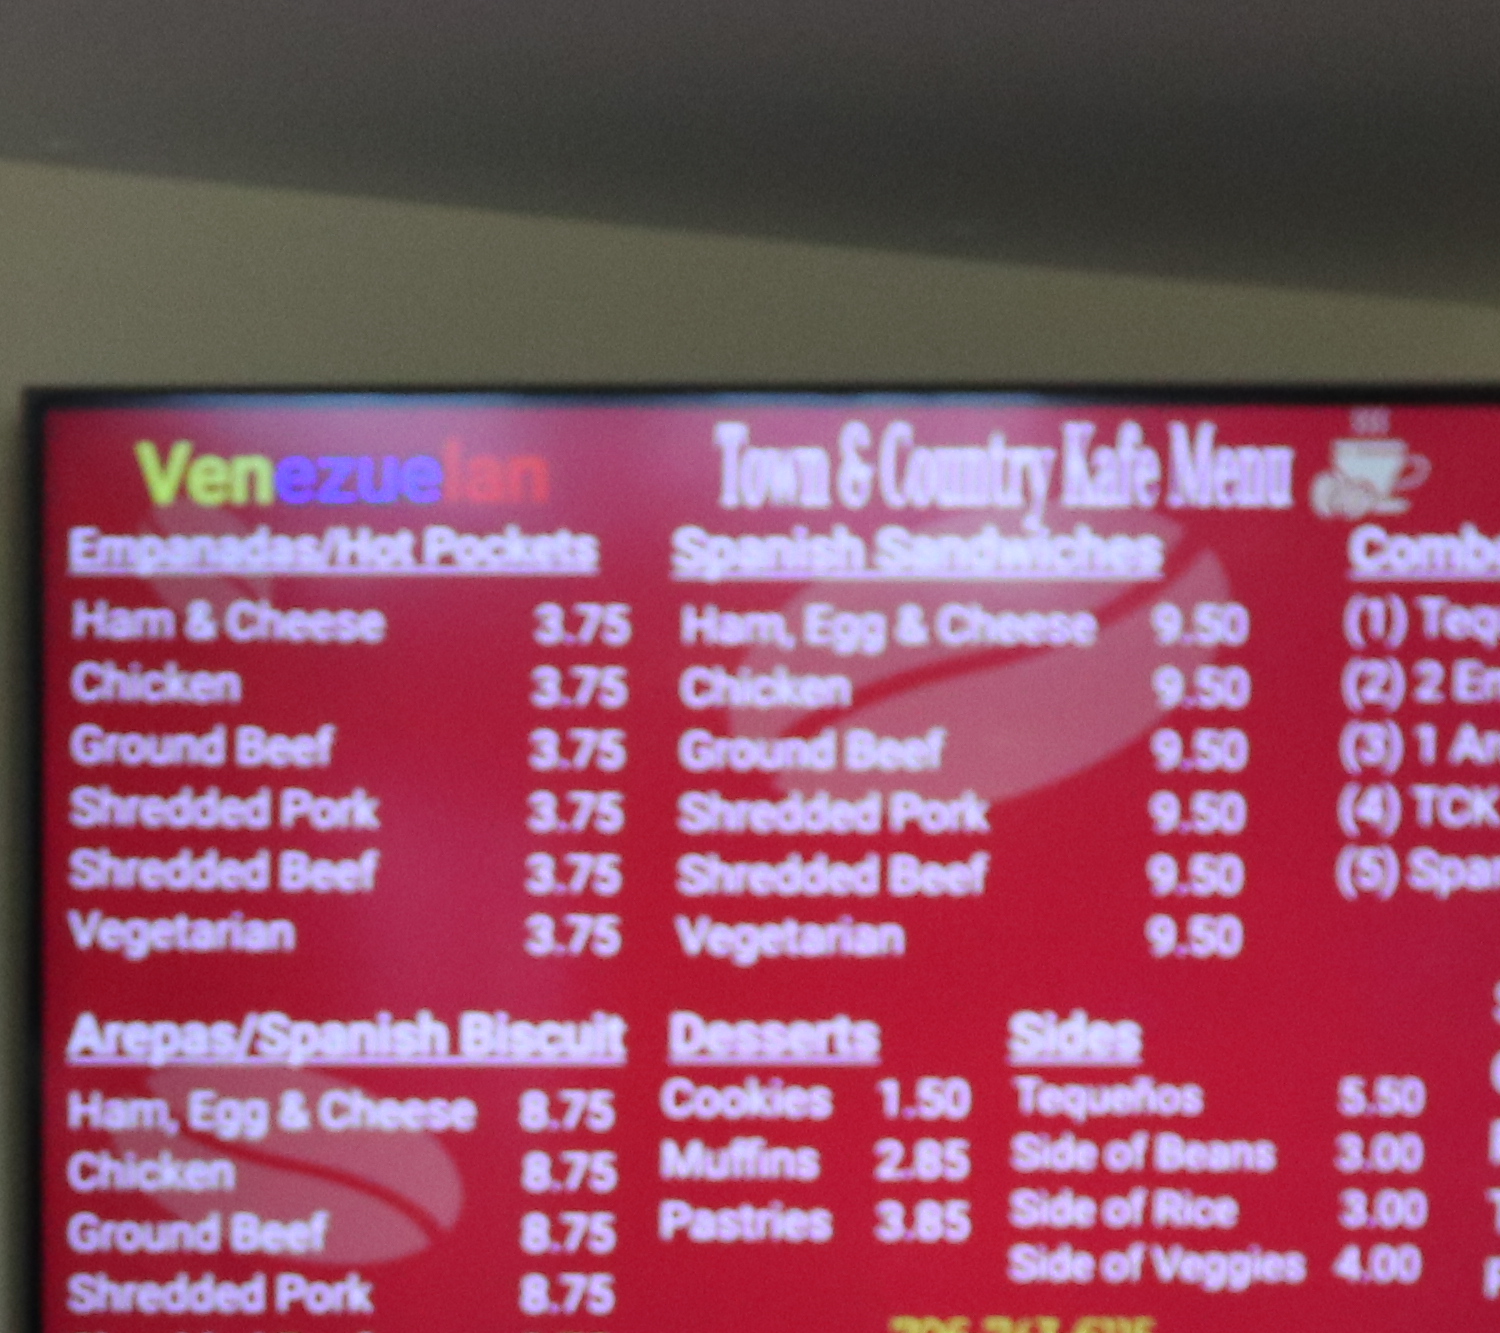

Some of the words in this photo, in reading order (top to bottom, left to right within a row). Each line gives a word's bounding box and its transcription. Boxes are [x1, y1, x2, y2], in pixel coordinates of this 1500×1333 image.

[134, 439, 550, 505] Venezuelan
[715, 421, 831, 508] Town
[839, 420, 876, 508] &
[880, 420, 1055, 531] Country
[1062, 420, 1160, 508] Kafe
[1168, 420, 1294, 508] Menu
[67, 525, 416, 576] Empanadas/Hot
[422, 525, 599, 573] Pockets
[671, 524, 867, 581] Spanish
[876, 523, 1165, 578] Sandwiches
[70, 600, 174, 640] Ham
[185, 600, 217, 640] &
[224, 599, 387, 642] Cheese
[532, 603, 631, 646] 3.75
[680, 604, 796, 651] Ham,
[803, 604, 888, 656] Egg
[896, 604, 928, 645] &
[935, 604, 1098, 646] Cheese
[1151, 602, 1250, 645] 9.50
[1344, 593, 1406, 649] (1)
[70, 661, 241, 703] Chicken
[530, 666, 628, 710] 3.75
[679, 665, 852, 709] Chicken
[1152, 665, 1252, 709] 9.50
[1341, 658, 1402, 712] (2)
[1413, 661, 1446, 704] 2
[68, 724, 226, 767] Ground
[235, 724, 336, 767] Beef
[527, 728, 626, 771] 3.75
[678, 727, 837, 771] Ground
[844, 727, 947, 771] Beef
[1150, 727, 1250, 772] 9.50
[1338, 721, 1403, 775] (3)
[1413, 724, 1438, 764] 1
[69, 785, 271, 829] Shredded
[279, 786, 380, 830] Pork
[525, 789, 625, 834] 3.75
[676, 789, 882, 834] Shredded
[889, 790, 991, 833] Pork
[1148, 790, 1248, 834] 9.50
[1336, 783, 1401, 838] (4)
[68, 847, 270, 890] Shredded
[278, 848, 379, 892] Beef
[524, 852, 623, 896] 3.75
[676, 852, 881, 897] Shredded
[888, 852, 991, 896] Beef
[1146, 852, 1246, 897] 9.50
[1335, 845, 1400, 901] (5)
[66, 908, 296, 962] Vegetarian
[523, 913, 622, 957] 3.75
[674, 914, 907, 968] Vegetarian
[1145, 913, 1244, 958] 9.50
[67, 1010, 449, 1067] Arepas/Spanish
[458, 1008, 627, 1064] Biscuit
[668, 1010, 880, 1065] Desserts
[1007, 1009, 1143, 1065] Sides
[67, 1090, 181, 1136] Ham,
[187, 1090, 270, 1140] Egg
[277, 1090, 310, 1131] &
[316, 1089, 479, 1132] Cheese
[518, 1089, 616, 1131] 8.75
[660, 1076, 834, 1120] Cookies
[876, 1076, 973, 1120] 1.50
[1336, 1075, 1427, 1117] 5.50
[67, 1149, 236, 1192] Chicken
[521, 1151, 617, 1193] 8.75
[660, 1138, 821, 1180] Muffins
[874, 1138, 971, 1181] 2.85
[1011, 1132, 1098, 1172] Side
[1103, 1132, 1147, 1172] of
[1153, 1133, 1276, 1173] Beans
[1334, 1132, 1425, 1173] 3.00
[66, 1211, 221, 1254] Ground
[229, 1211, 329, 1254] Beef
[520, 1211, 617, 1254] 8.75
[659, 1200, 834, 1243] Pastries
[873, 1199, 972, 1243] 3.85
[1010, 1188, 1097, 1229] Side
[1103, 1188, 1147, 1228] of
[1153, 1189, 1239, 1229] Rice
[1338, 1188, 1429, 1229] 3.00
[1008, 1244, 1095, 1283] Side
[1100, 1244, 1145, 1283] of
[1150, 1244, 1307, 1292] Veggies
[1332, 1244, 1423, 1284] 4.00
[66, 1271, 267, 1314] Shredded
[274, 1271, 375, 1314] Pork
[519, 1273, 616, 1315] 8.75
